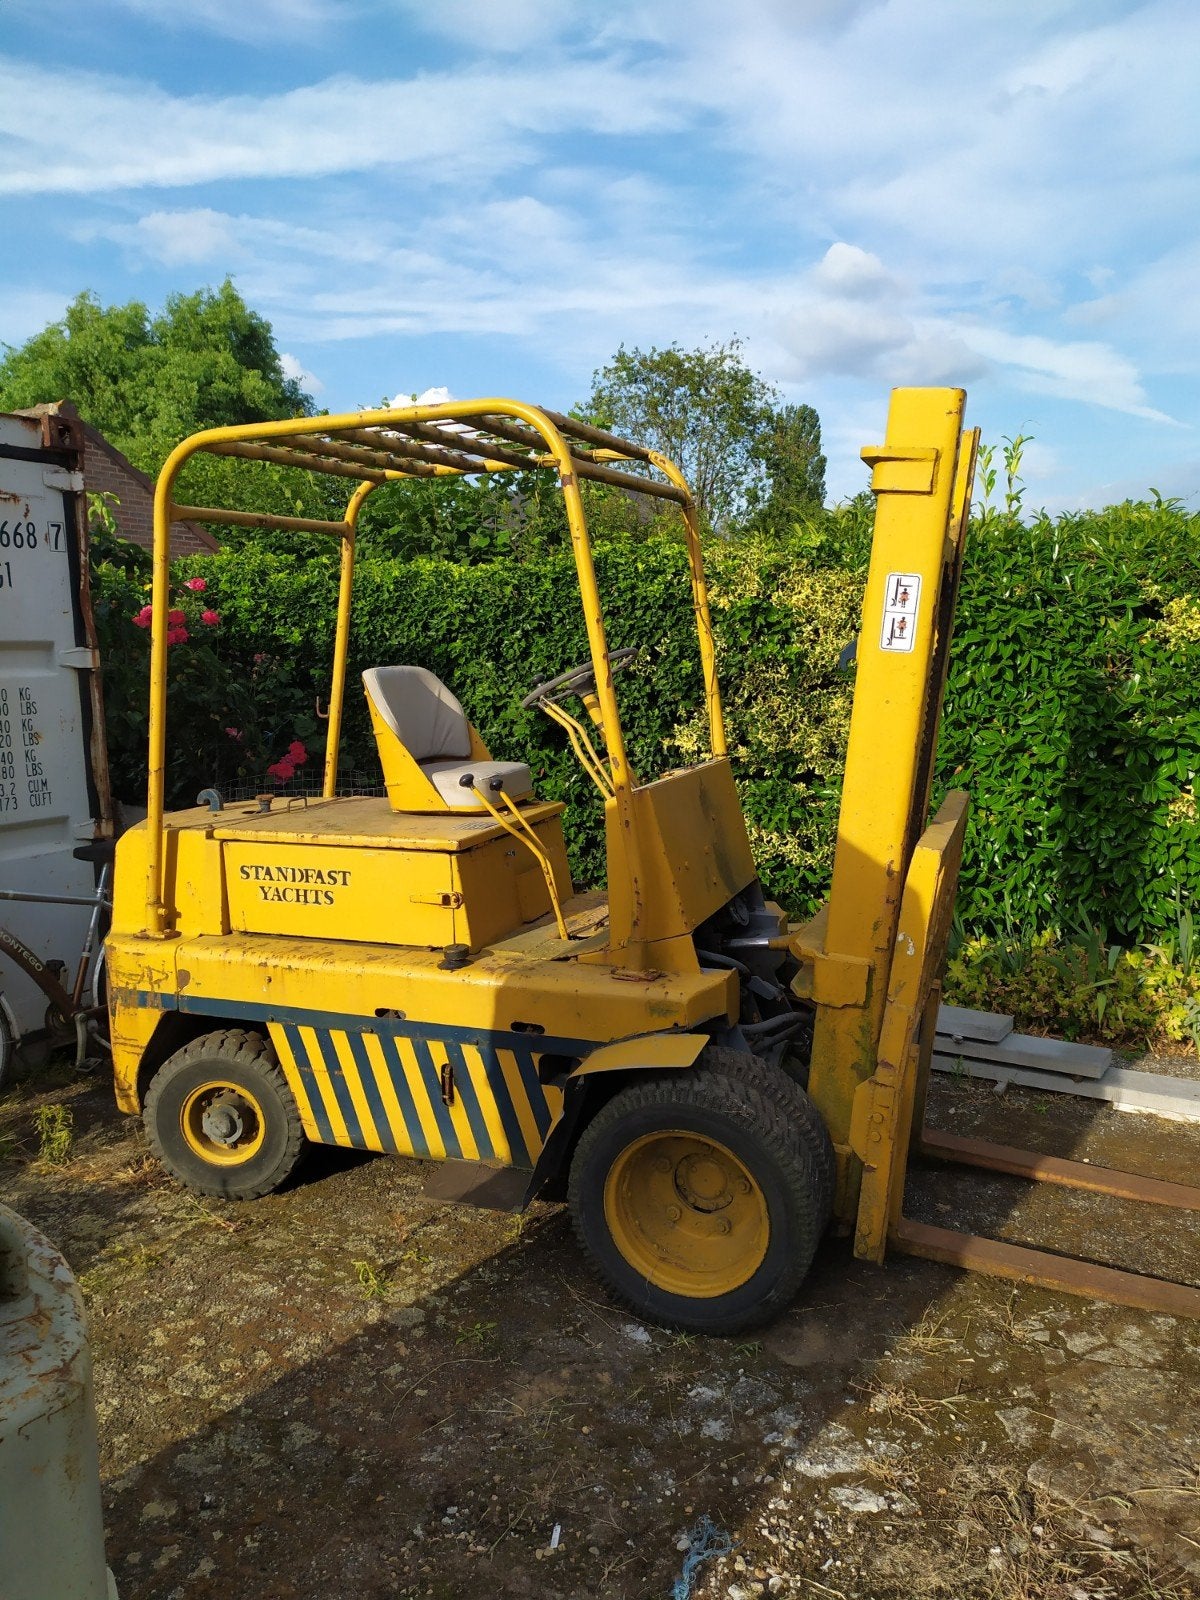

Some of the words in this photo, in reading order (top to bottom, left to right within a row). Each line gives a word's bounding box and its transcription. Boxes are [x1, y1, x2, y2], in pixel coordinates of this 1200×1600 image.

[50, 523, 62, 549] 7
[19, 687, 31, 701] KG
[20, 701, 38, 715] LBS
[22, 718, 33, 732] KG
[23, 731, 40, 746] LBS
[25, 749, 37, 763] KG
[26, 762, 43, 777] LBS
[240, 865, 351, 886] STANDFAST
[259, 885, 335, 906] YACHTS
